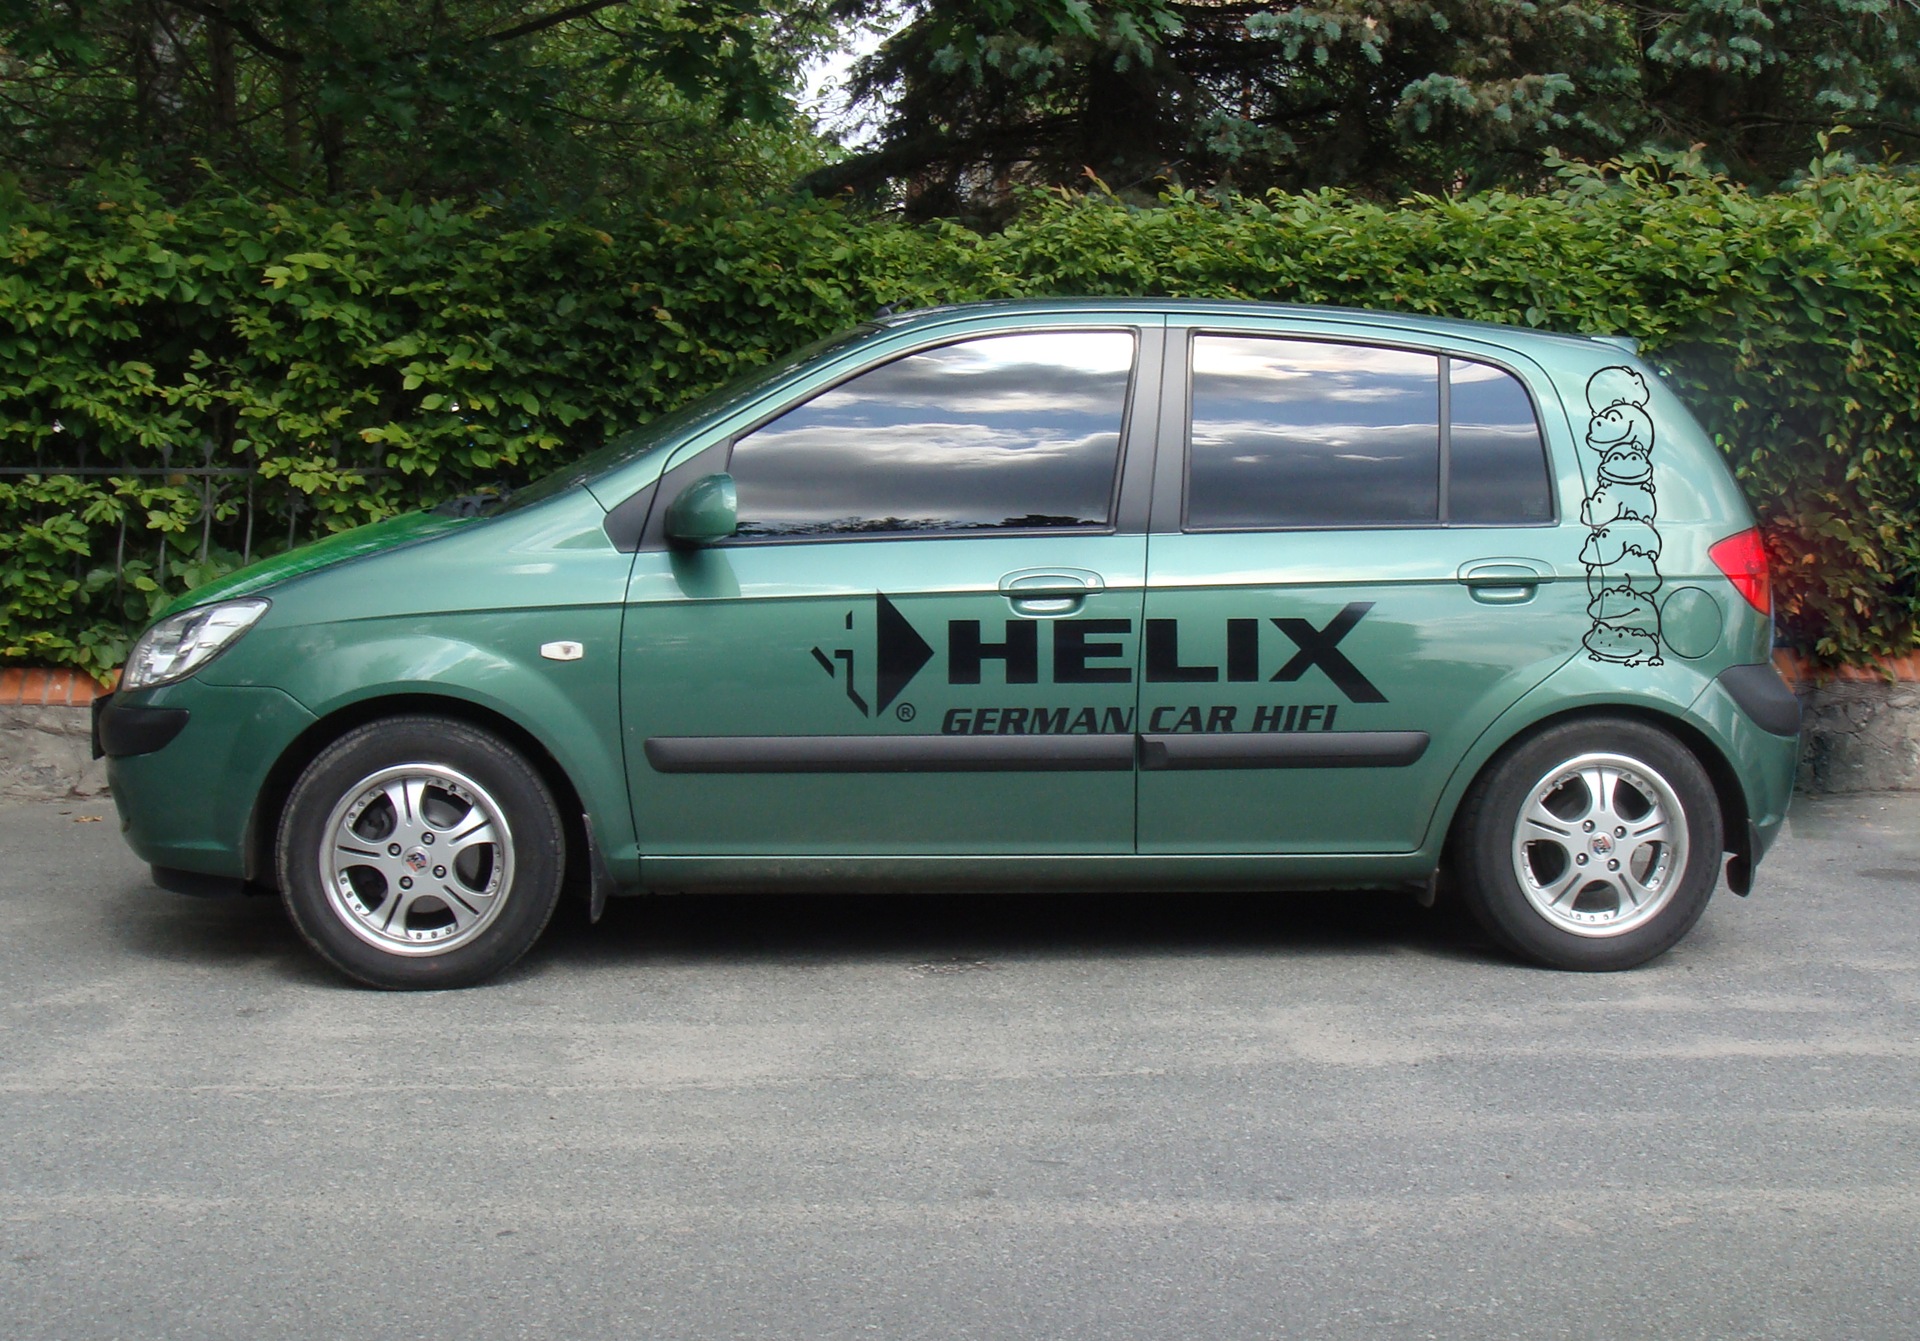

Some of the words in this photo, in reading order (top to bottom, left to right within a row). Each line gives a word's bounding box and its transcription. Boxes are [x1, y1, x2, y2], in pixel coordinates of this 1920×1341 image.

[948, 602, 1390, 703] HELIX
[941, 706, 1135, 734] GERMAN
[1148, 705, 1238, 732] CAR
[1251, 704, 1338, 731] HIFI
